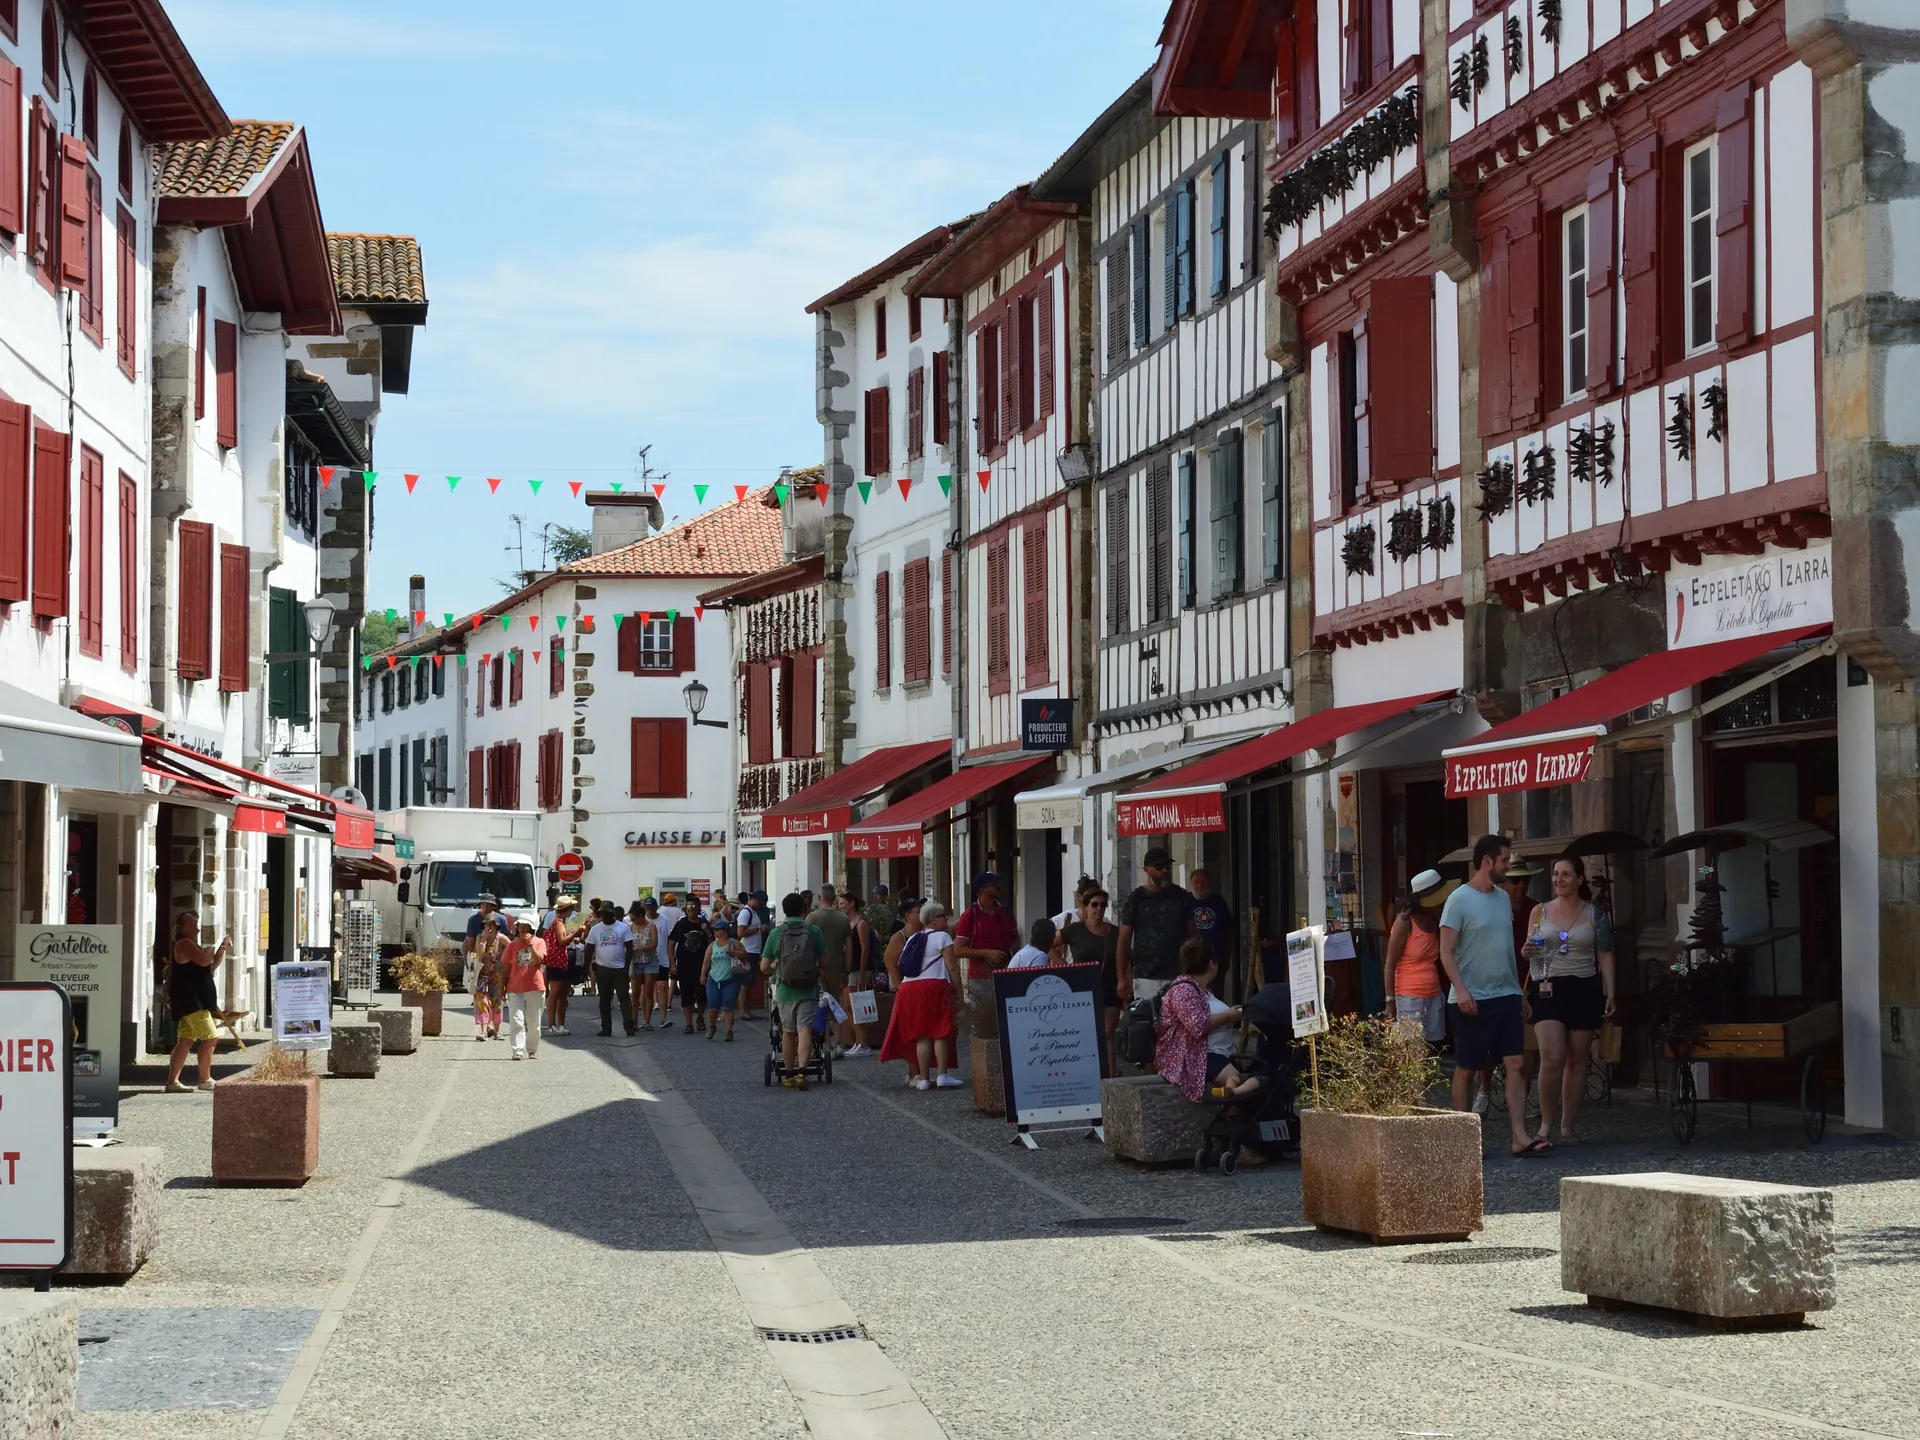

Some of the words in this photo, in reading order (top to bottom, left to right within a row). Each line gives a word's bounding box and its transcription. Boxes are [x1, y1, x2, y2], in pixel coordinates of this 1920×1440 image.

[1692, 571, 1772, 607] EZPELETAKO
[1779, 557, 1829, 588] IZARRA
[1028, 723, 1067, 732] PRODUCTEUR
[1028, 732, 1034, 743] À
[1035, 733, 1067, 743] ESPELETTE
[1455, 759, 1528, 793] EZPELETAKO
[1535, 751, 1584, 783] IZARRA
[1041, 807, 1057, 824] SOKA
[1136, 804, 1181, 830] PATCHAMAMA
[624, 831, 692, 846] CAISSE
[30, 932, 109, 963] Gastellou
[50, 973, 90, 982] ELEVEUR
[1008, 1003, 1059, 1014] EZPELETAKO
[1062, 1001, 1092, 1009] IZARRA
[1027, 1028, 1081, 1039] Productrice
[1029, 1044, 1041, 1052] de
[1045, 1040, 1081, 1050] Piment
[1027, 1053, 1083, 1067] d'Espelette
